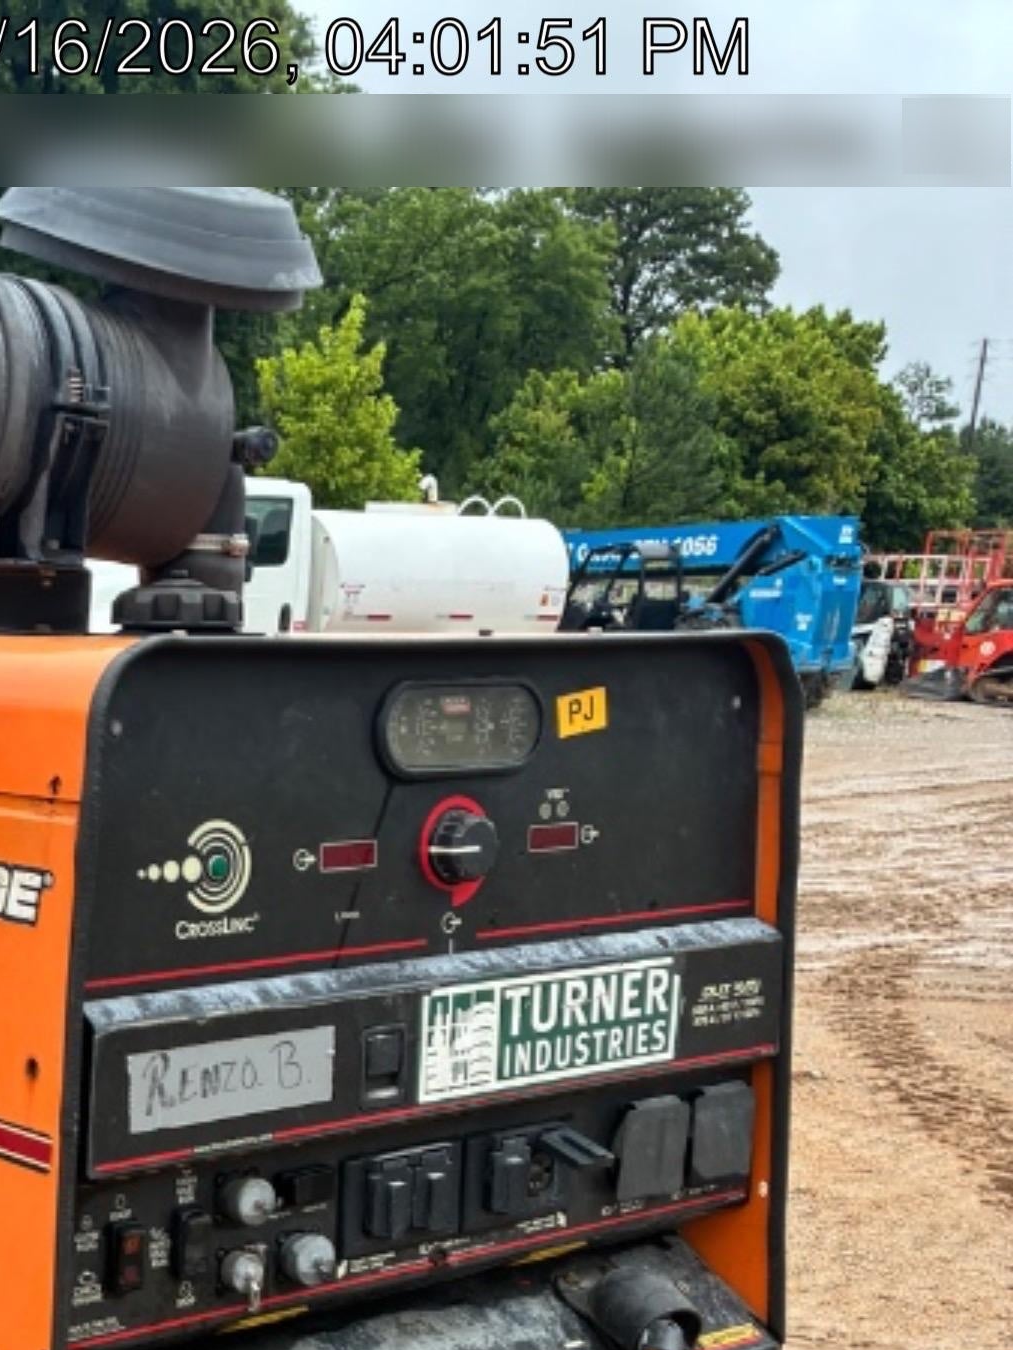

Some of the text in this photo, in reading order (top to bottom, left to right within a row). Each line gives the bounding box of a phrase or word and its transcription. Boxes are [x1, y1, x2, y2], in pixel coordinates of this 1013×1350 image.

[568, 695, 594, 725] PJ
[504, 968, 669, 1036] TURNER
[502, 1019, 667, 1078] INDUSTRIES
